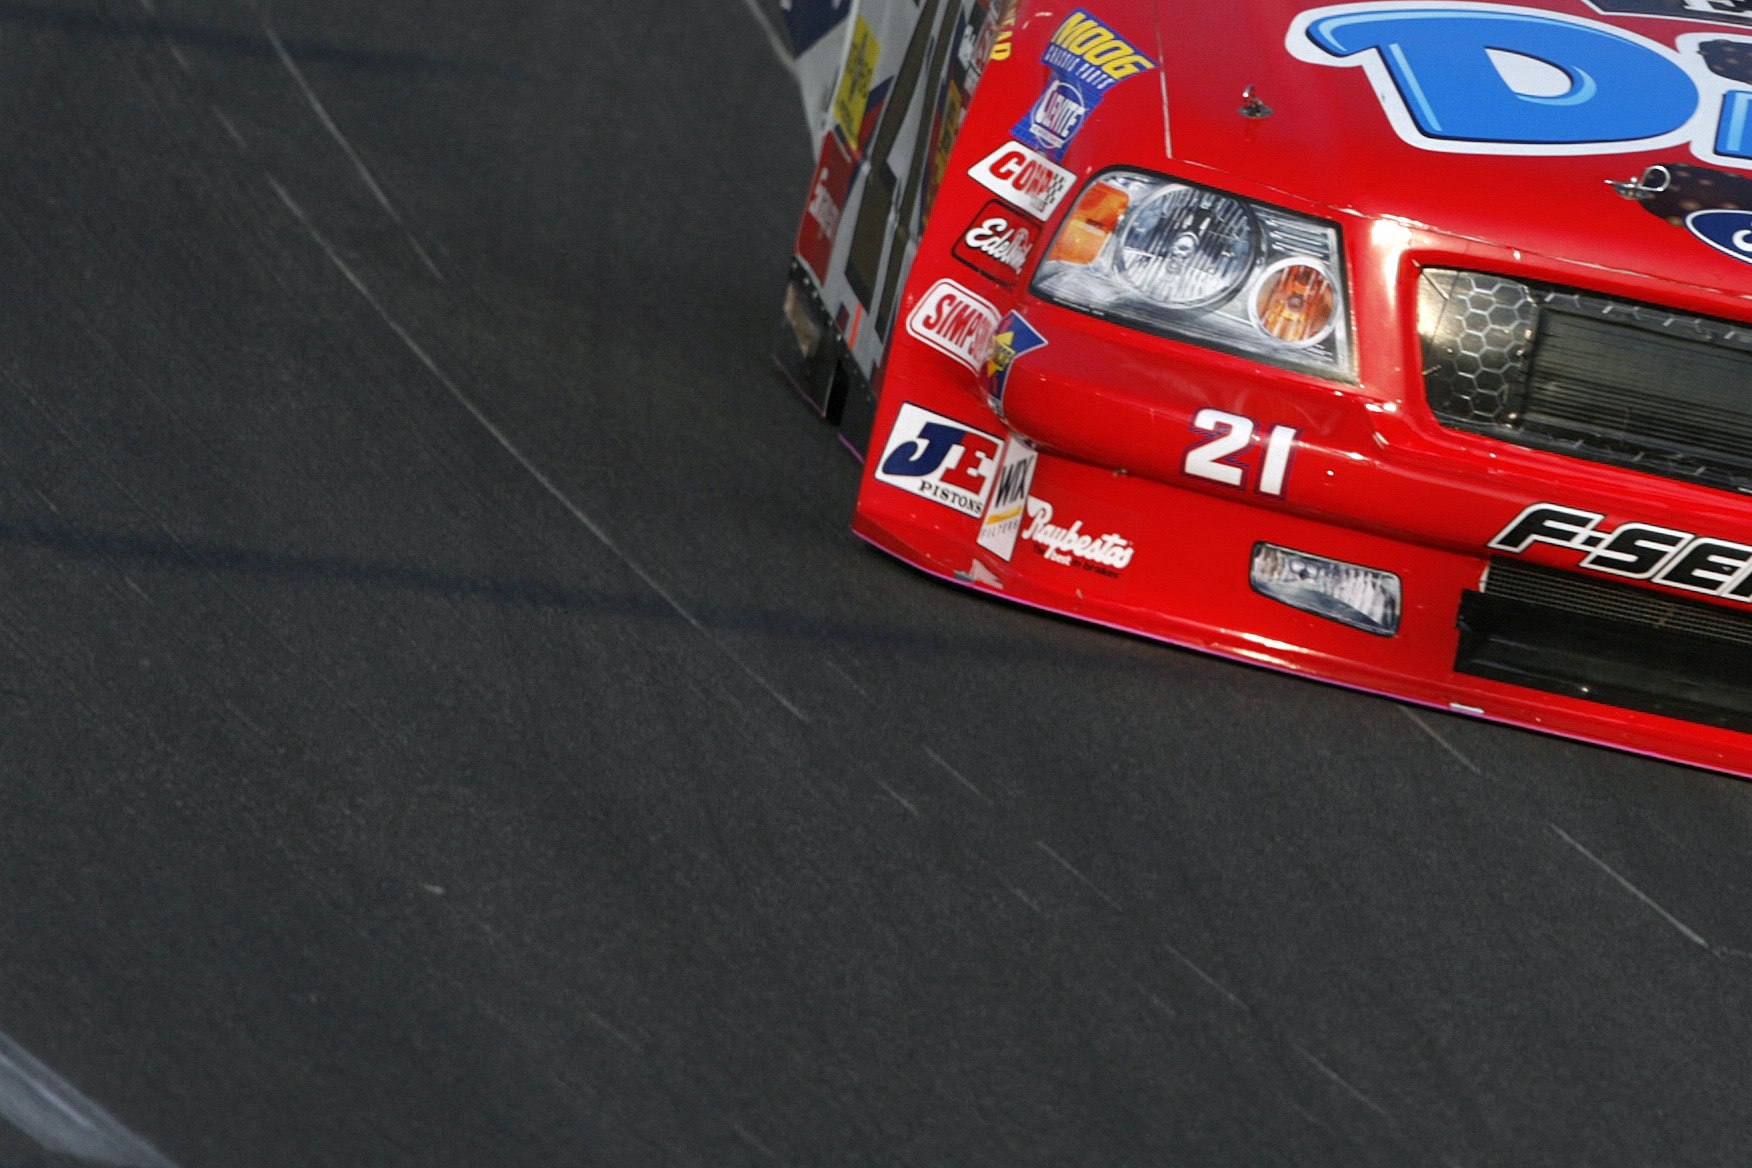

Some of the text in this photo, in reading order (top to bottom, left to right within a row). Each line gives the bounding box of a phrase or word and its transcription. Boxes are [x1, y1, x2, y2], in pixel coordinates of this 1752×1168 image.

[1050, 11, 1157, 80] MOOG
[881, 421, 1000, 495] JE
[1183, 407, 1298, 496] 21
[919, 480, 984, 516] PISTONS
[1021, 494, 1135, 570] Raybestos
